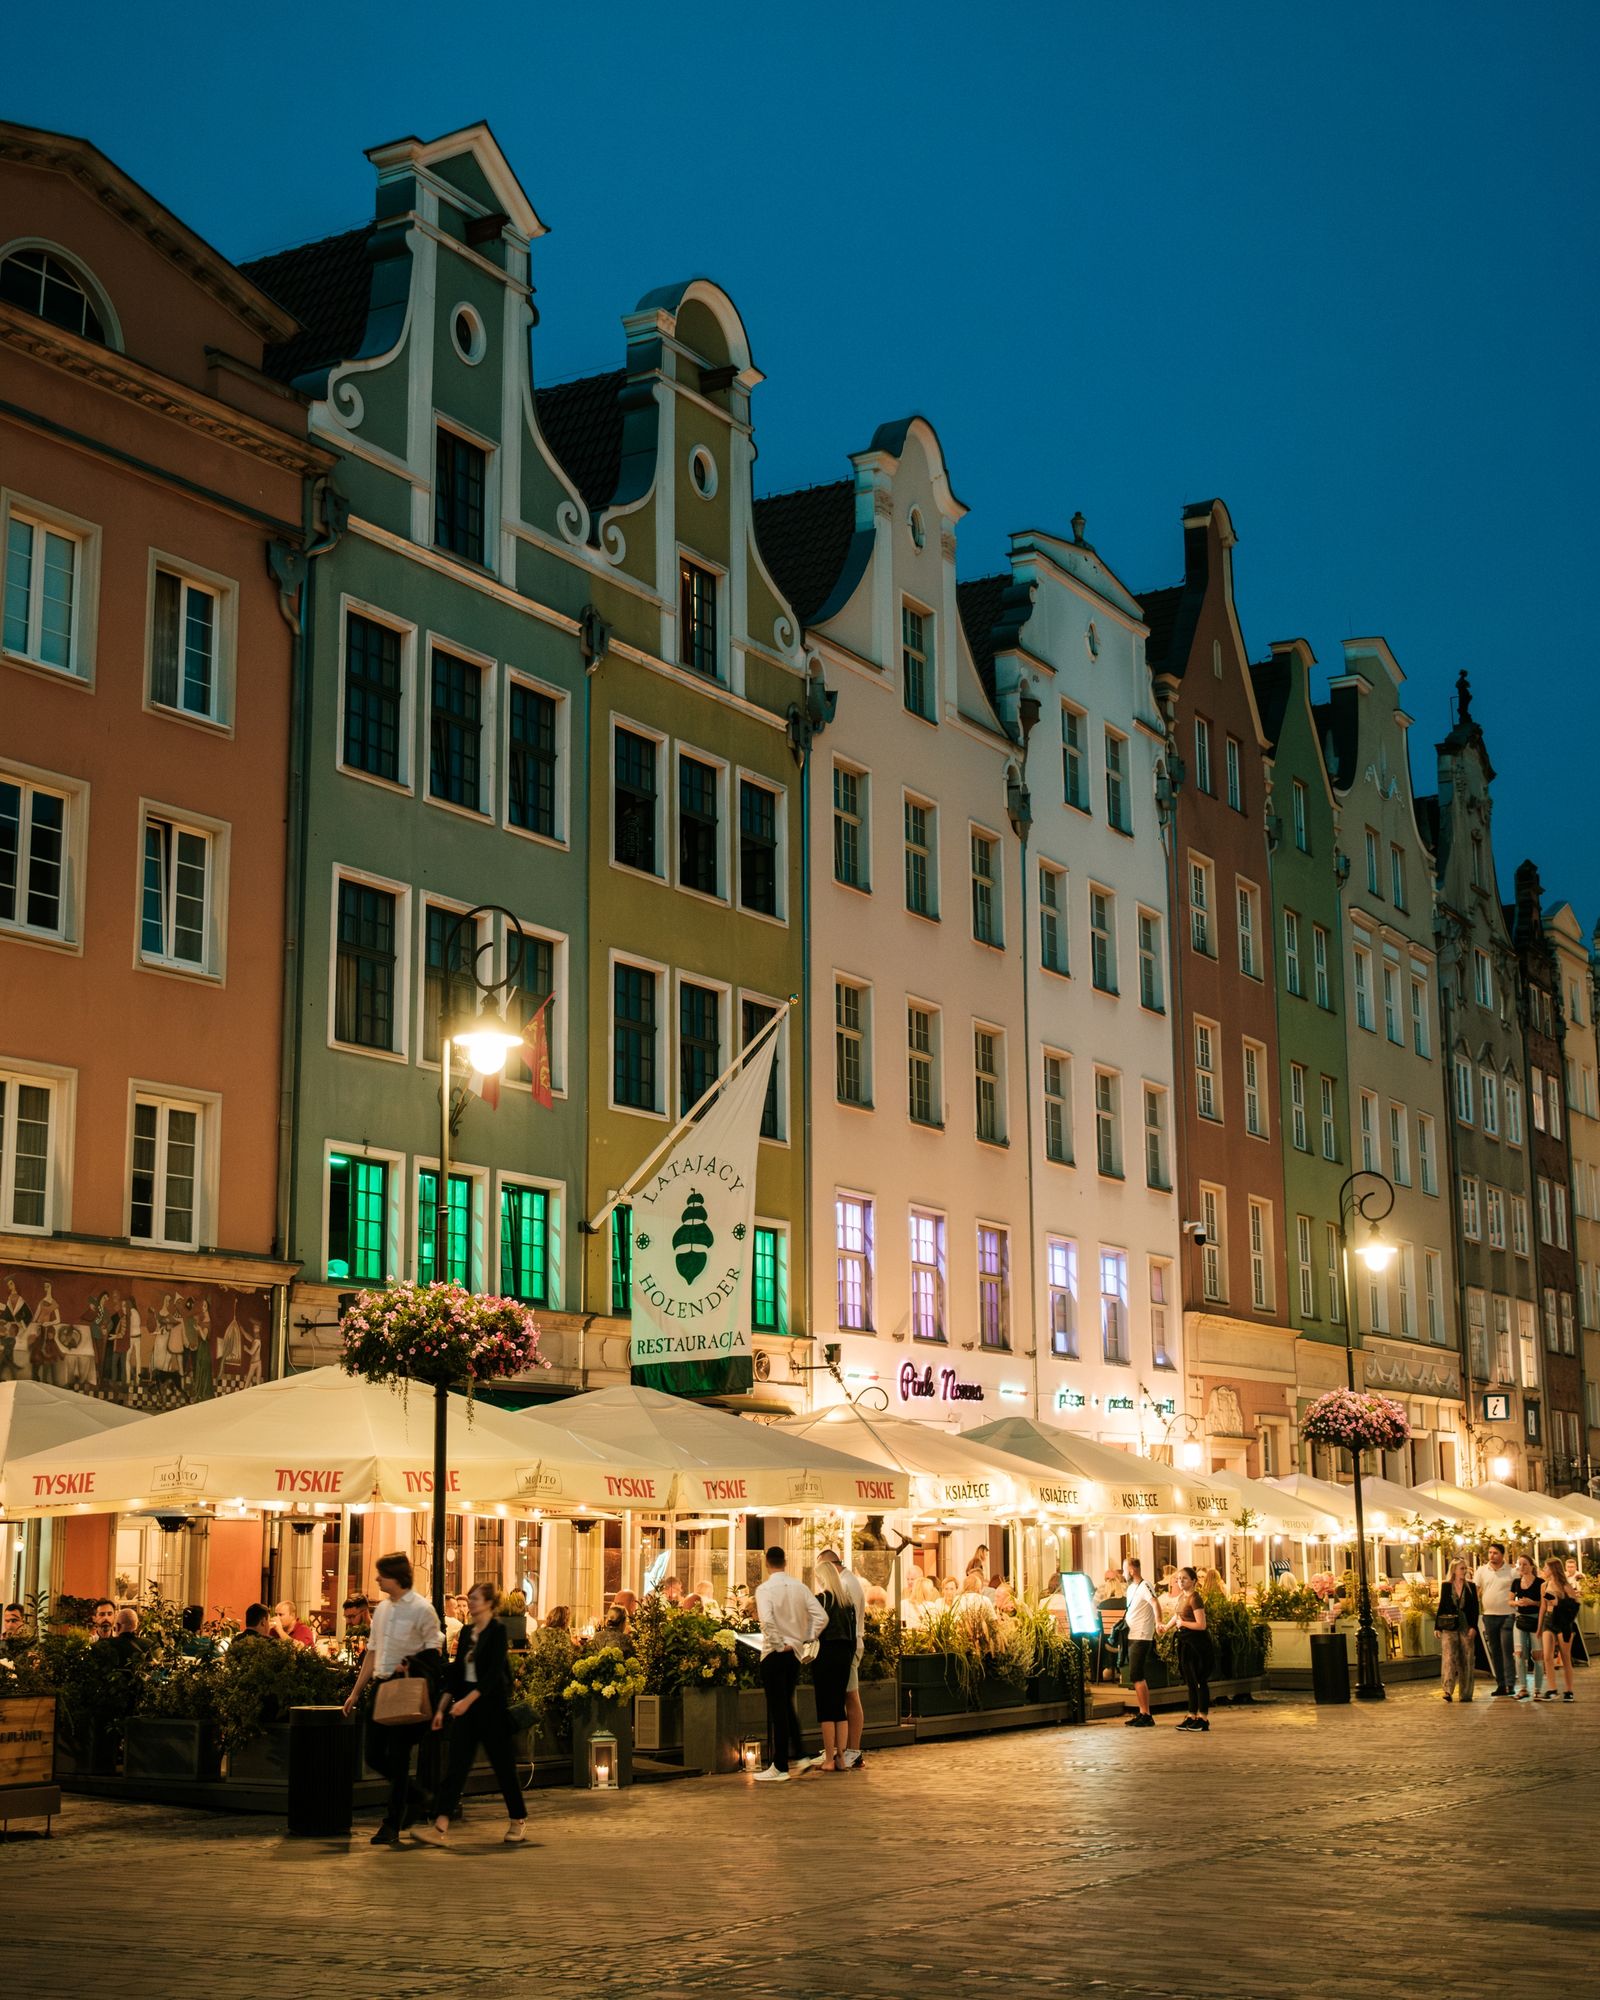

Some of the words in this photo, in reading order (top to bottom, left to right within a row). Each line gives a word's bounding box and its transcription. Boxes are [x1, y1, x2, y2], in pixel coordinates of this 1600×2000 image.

[642, 1155, 745, 1204] LATAJĄCY
[638, 1267, 741, 1319] HOLENDER
[637, 1331, 745, 1355] RESTAURACJA
[900, 1362, 935, 1401] Pink
[941, 1369, 984, 1401] Nonna
[1059, 1388, 1085, 1408] pizza
[1108, 1397, 1133, 1413] pasta
[32, 1472, 96, 1496] TYSKIE
[275, 1469, 344, 1493] TYSKIE
[402, 1470, 461, 1493] TYSIE
[604, 1475, 656, 1499] TYSKIE
[703, 1479, 748, 1500] TYSKIE
[855, 1480, 896, 1500] TYSKIE
[945, 1481, 990, 1502] KSIĄŻĘCE
